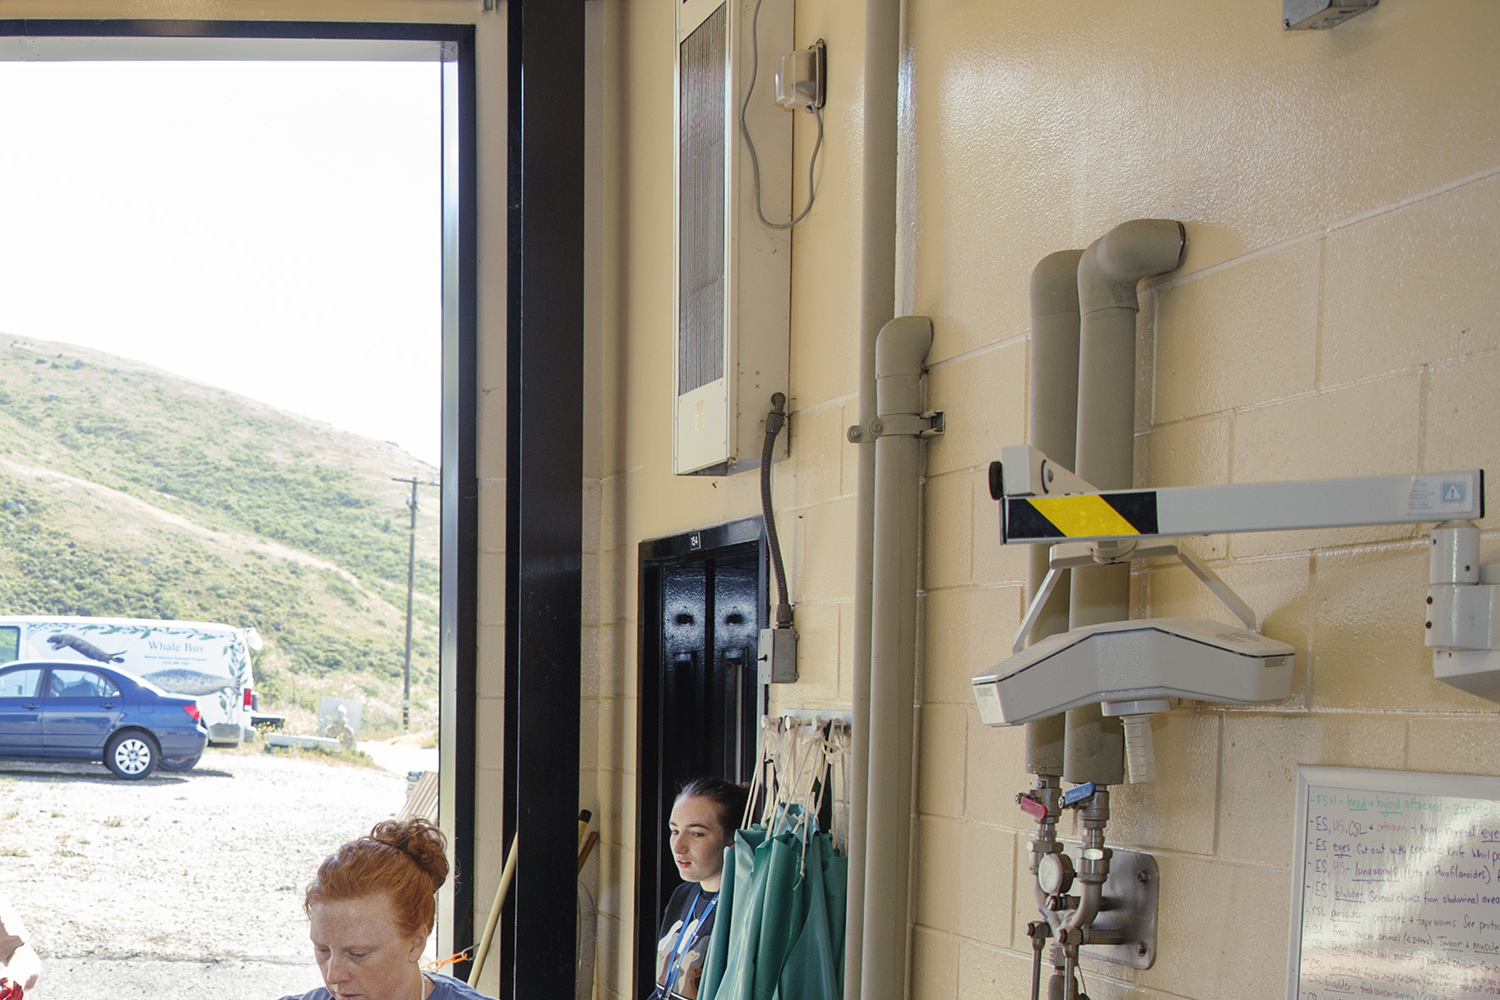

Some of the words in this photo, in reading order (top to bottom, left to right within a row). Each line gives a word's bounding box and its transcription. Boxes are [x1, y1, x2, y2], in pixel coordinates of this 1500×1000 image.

[148, 640, 181, 652] Whale
[184, 642, 204, 652] Bus
[1347, 794, 1366, 808] head
[1315, 881, 1327, 897] ES
